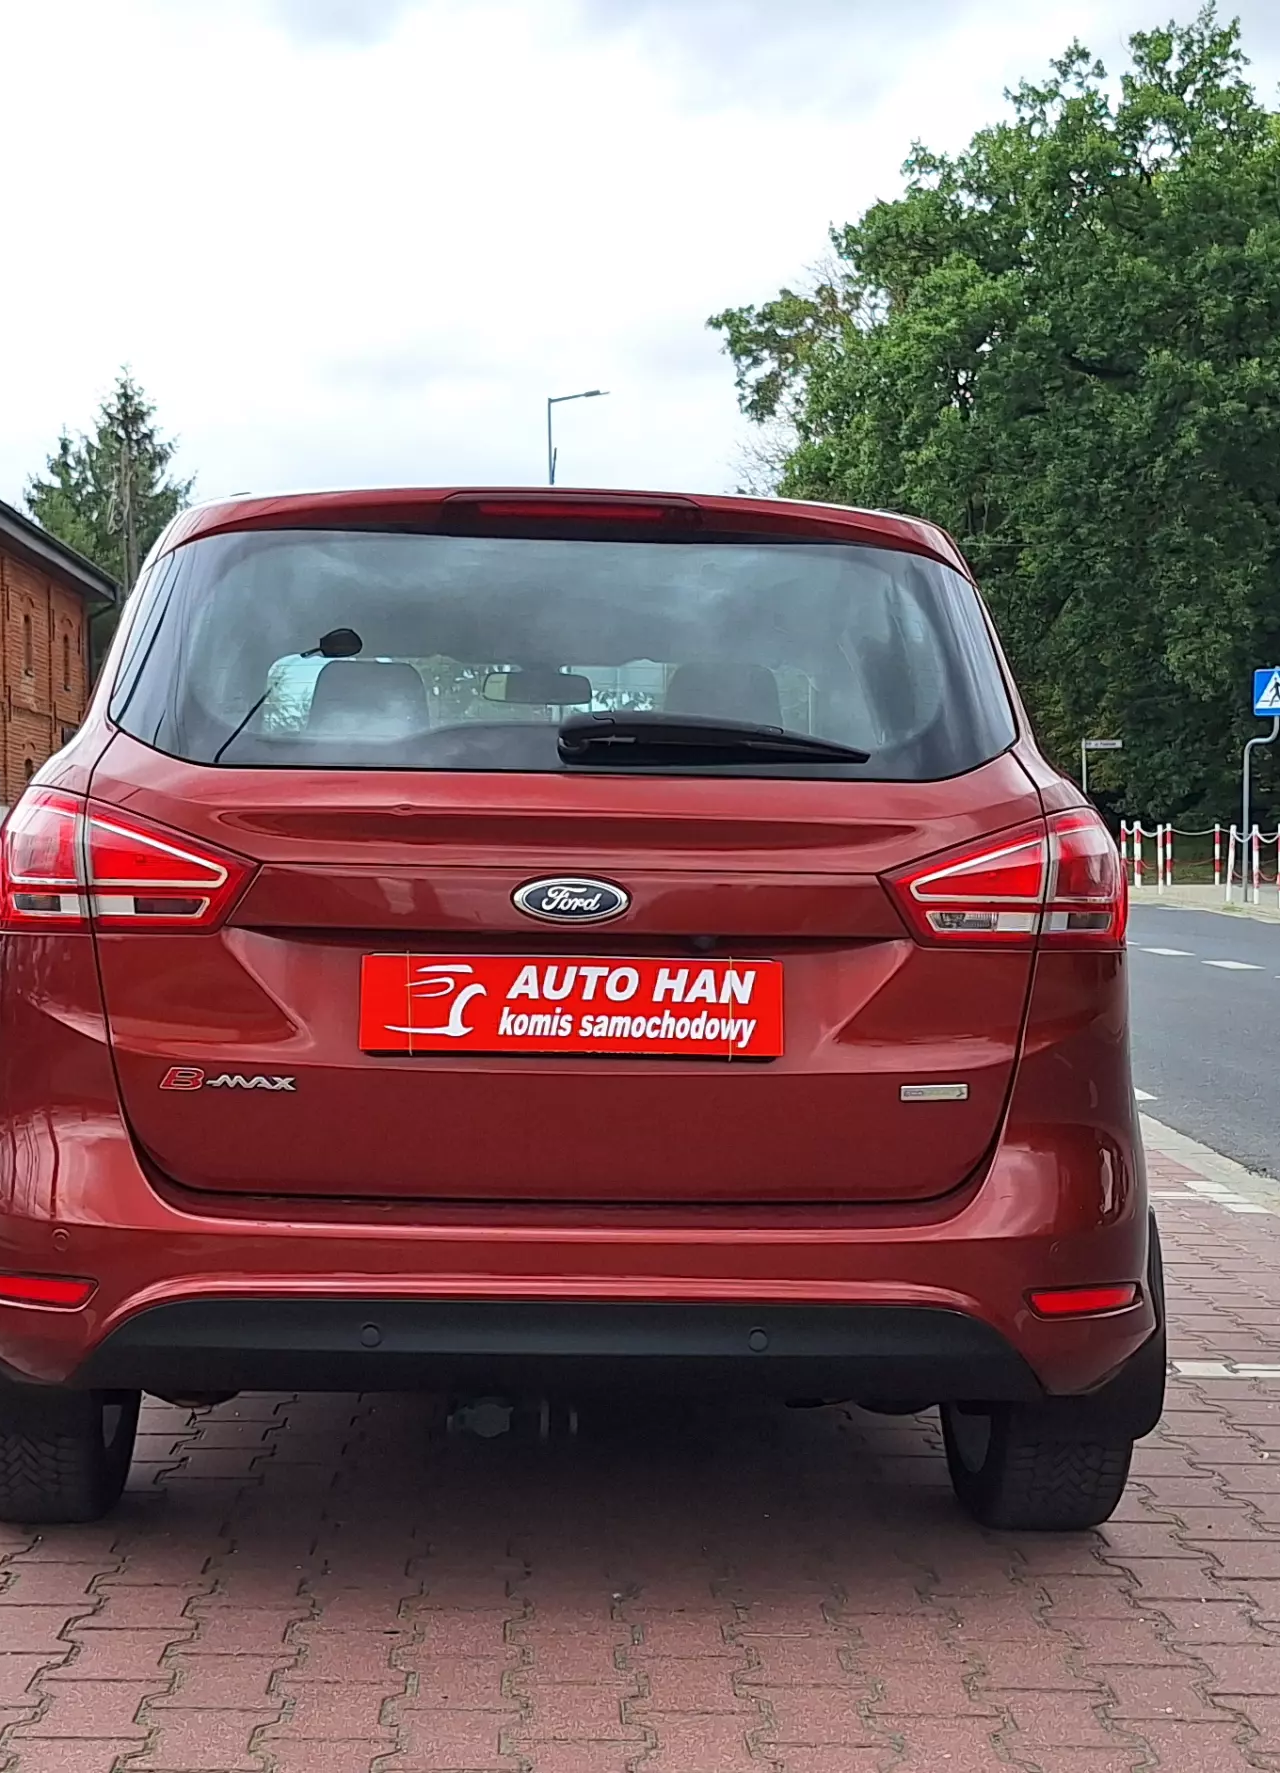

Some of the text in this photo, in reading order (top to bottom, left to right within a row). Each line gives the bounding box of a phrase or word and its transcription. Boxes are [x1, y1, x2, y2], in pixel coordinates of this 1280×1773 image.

[541, 885, 602, 911] Ford
[506, 964, 757, 1005] AUTO HAN
[497, 1006, 757, 1049] komis samochodowy
[159, 1066, 297, 1091] B-MAX
